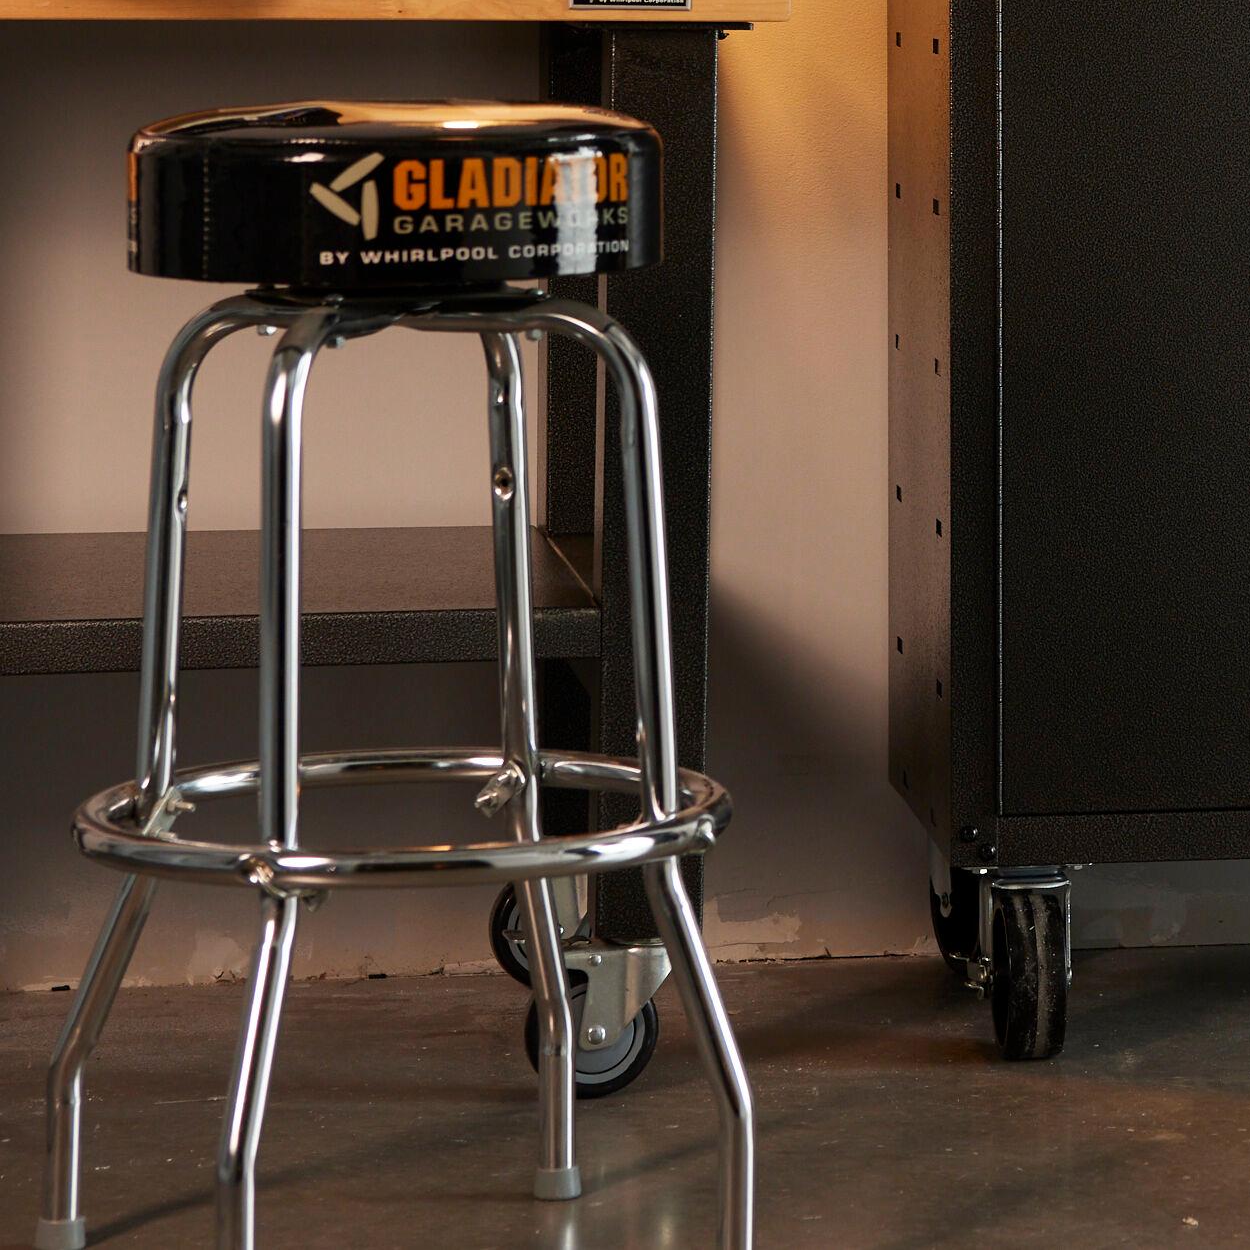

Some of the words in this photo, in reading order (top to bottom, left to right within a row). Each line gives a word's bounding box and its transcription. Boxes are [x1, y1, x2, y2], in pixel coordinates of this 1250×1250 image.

[393, 152, 629, 211] GLADIATOR
[393, 206, 629, 235] GARAGEWOKS
[319, 251, 350, 266] BY
[360, 247, 498, 265] WHIRLPOOL
[507, 240, 630, 259] CORPORATION
